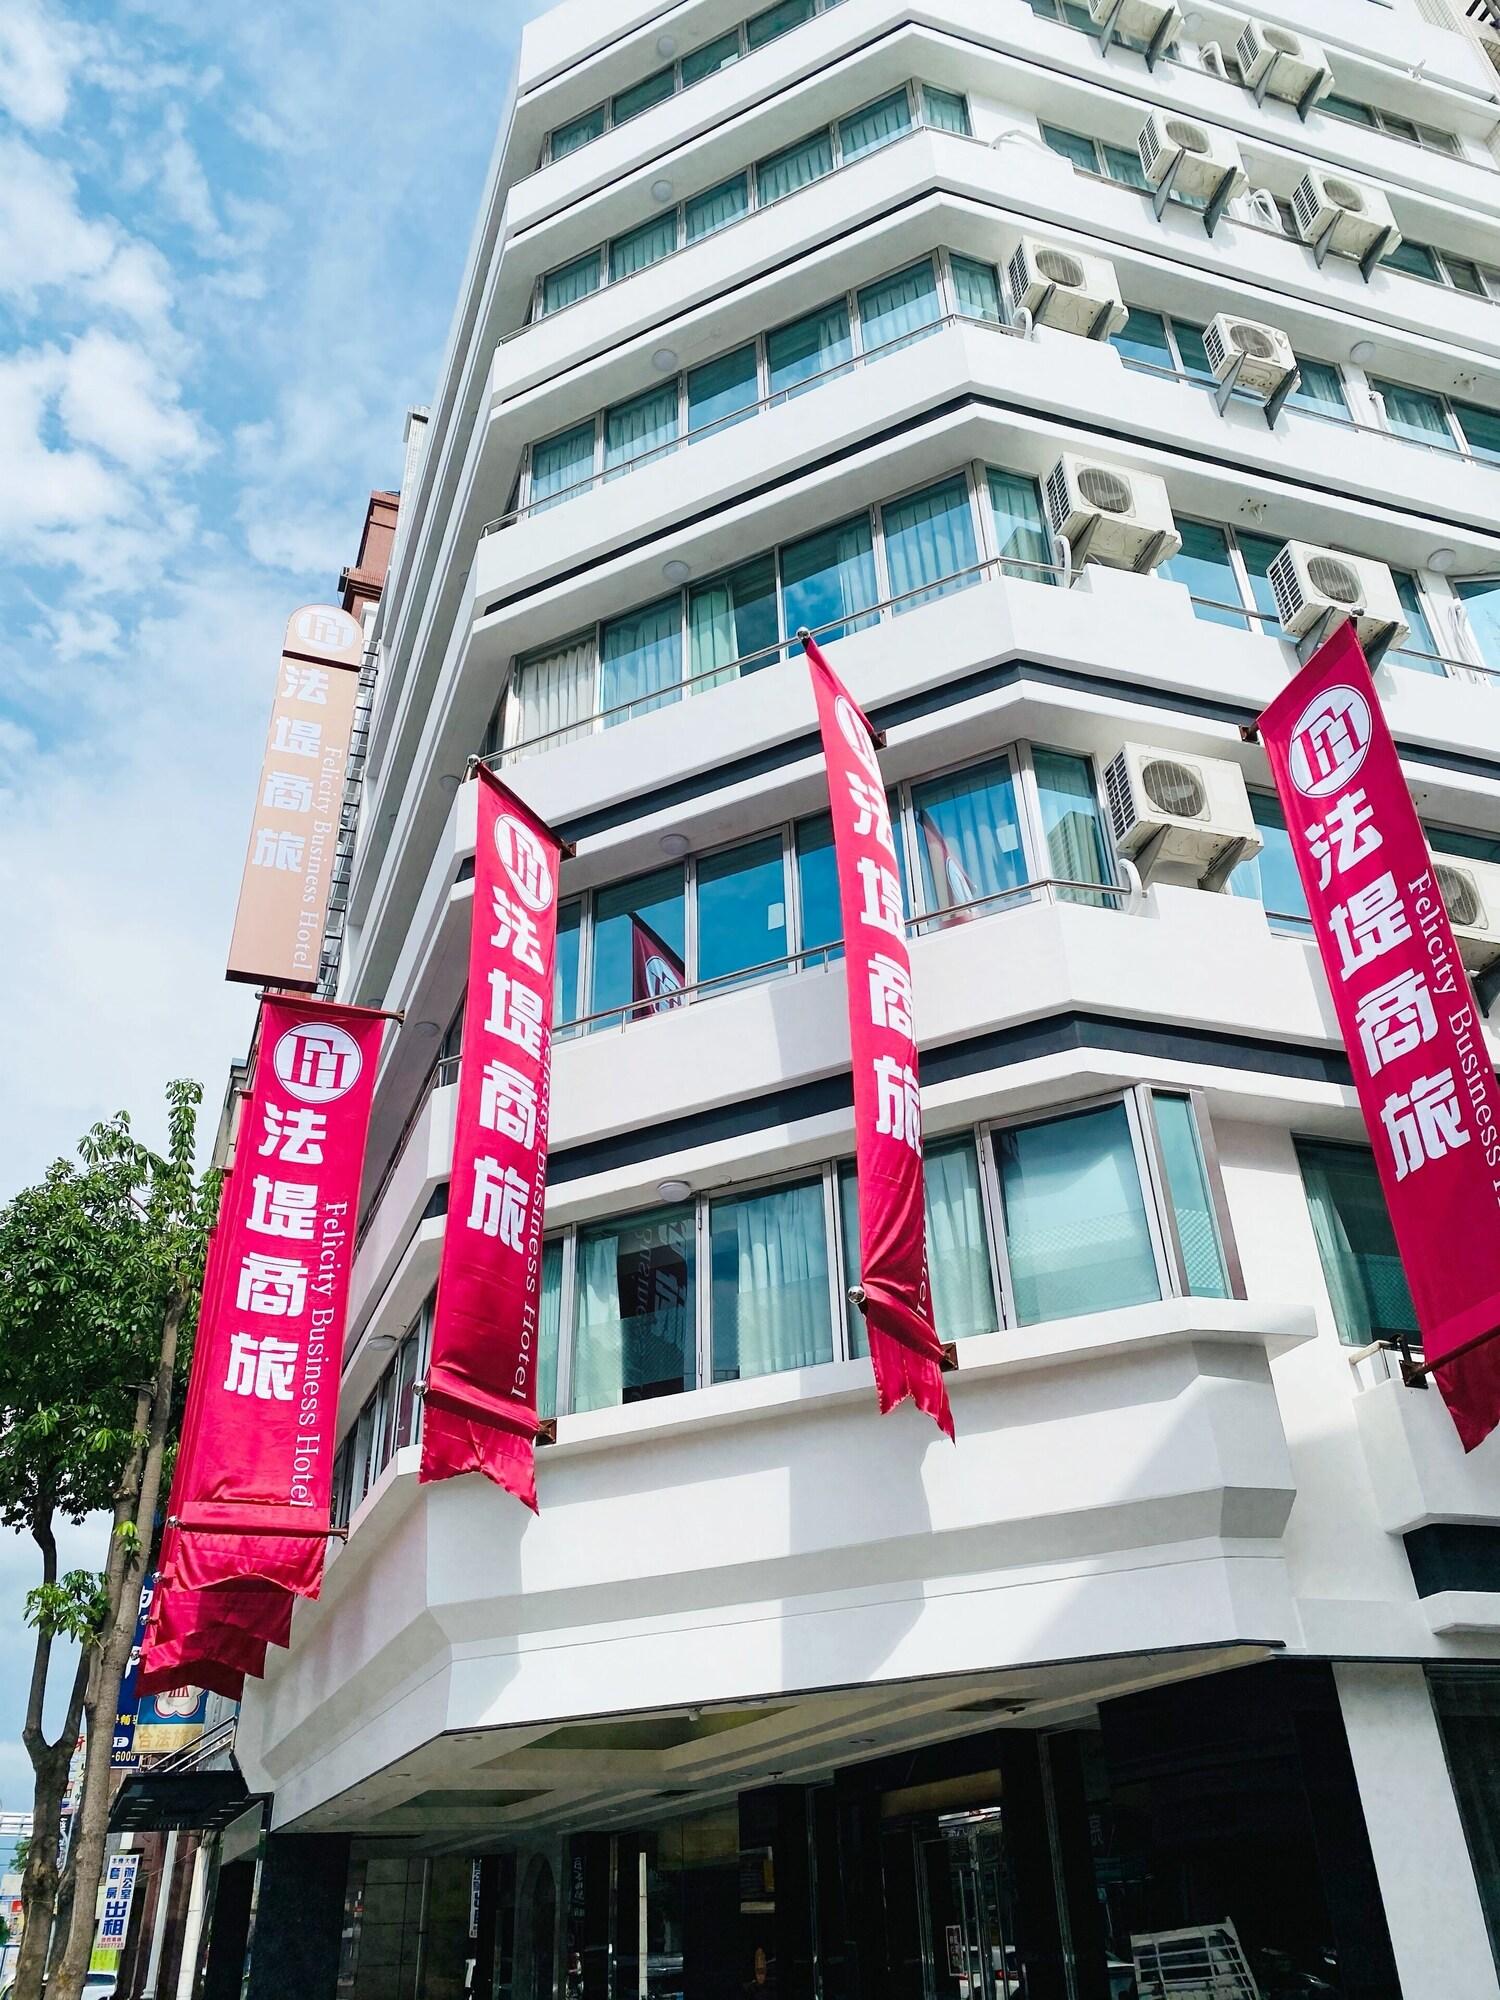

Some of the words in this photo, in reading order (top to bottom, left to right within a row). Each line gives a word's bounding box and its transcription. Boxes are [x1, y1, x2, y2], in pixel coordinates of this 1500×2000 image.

[252, 664, 329, 873] 法堤商旅
[313, 745, 344, 819] Felicity
[303, 821, 333, 905] Business
[292, 910, 320, 970] Hotel
[1305, 787, 1472, 1184] 法堤商旅
[466, 885, 545, 1256] 法堤商旅
[1408, 868, 1458, 995] Felicity
[1448, 1002, 1500, 1168] Business
[222, 1101, 328, 1401] 法堤商旅
[309, 1200, 349, 1300] Felicity
[526, 1147, 549, 1293] Business
[302, 1308, 336, 1426] Business
[510, 1300, 536, 1399] Hotel
[289, 1432, 322, 1508] Hotel
[102, 1901, 128, 1936] 出租
